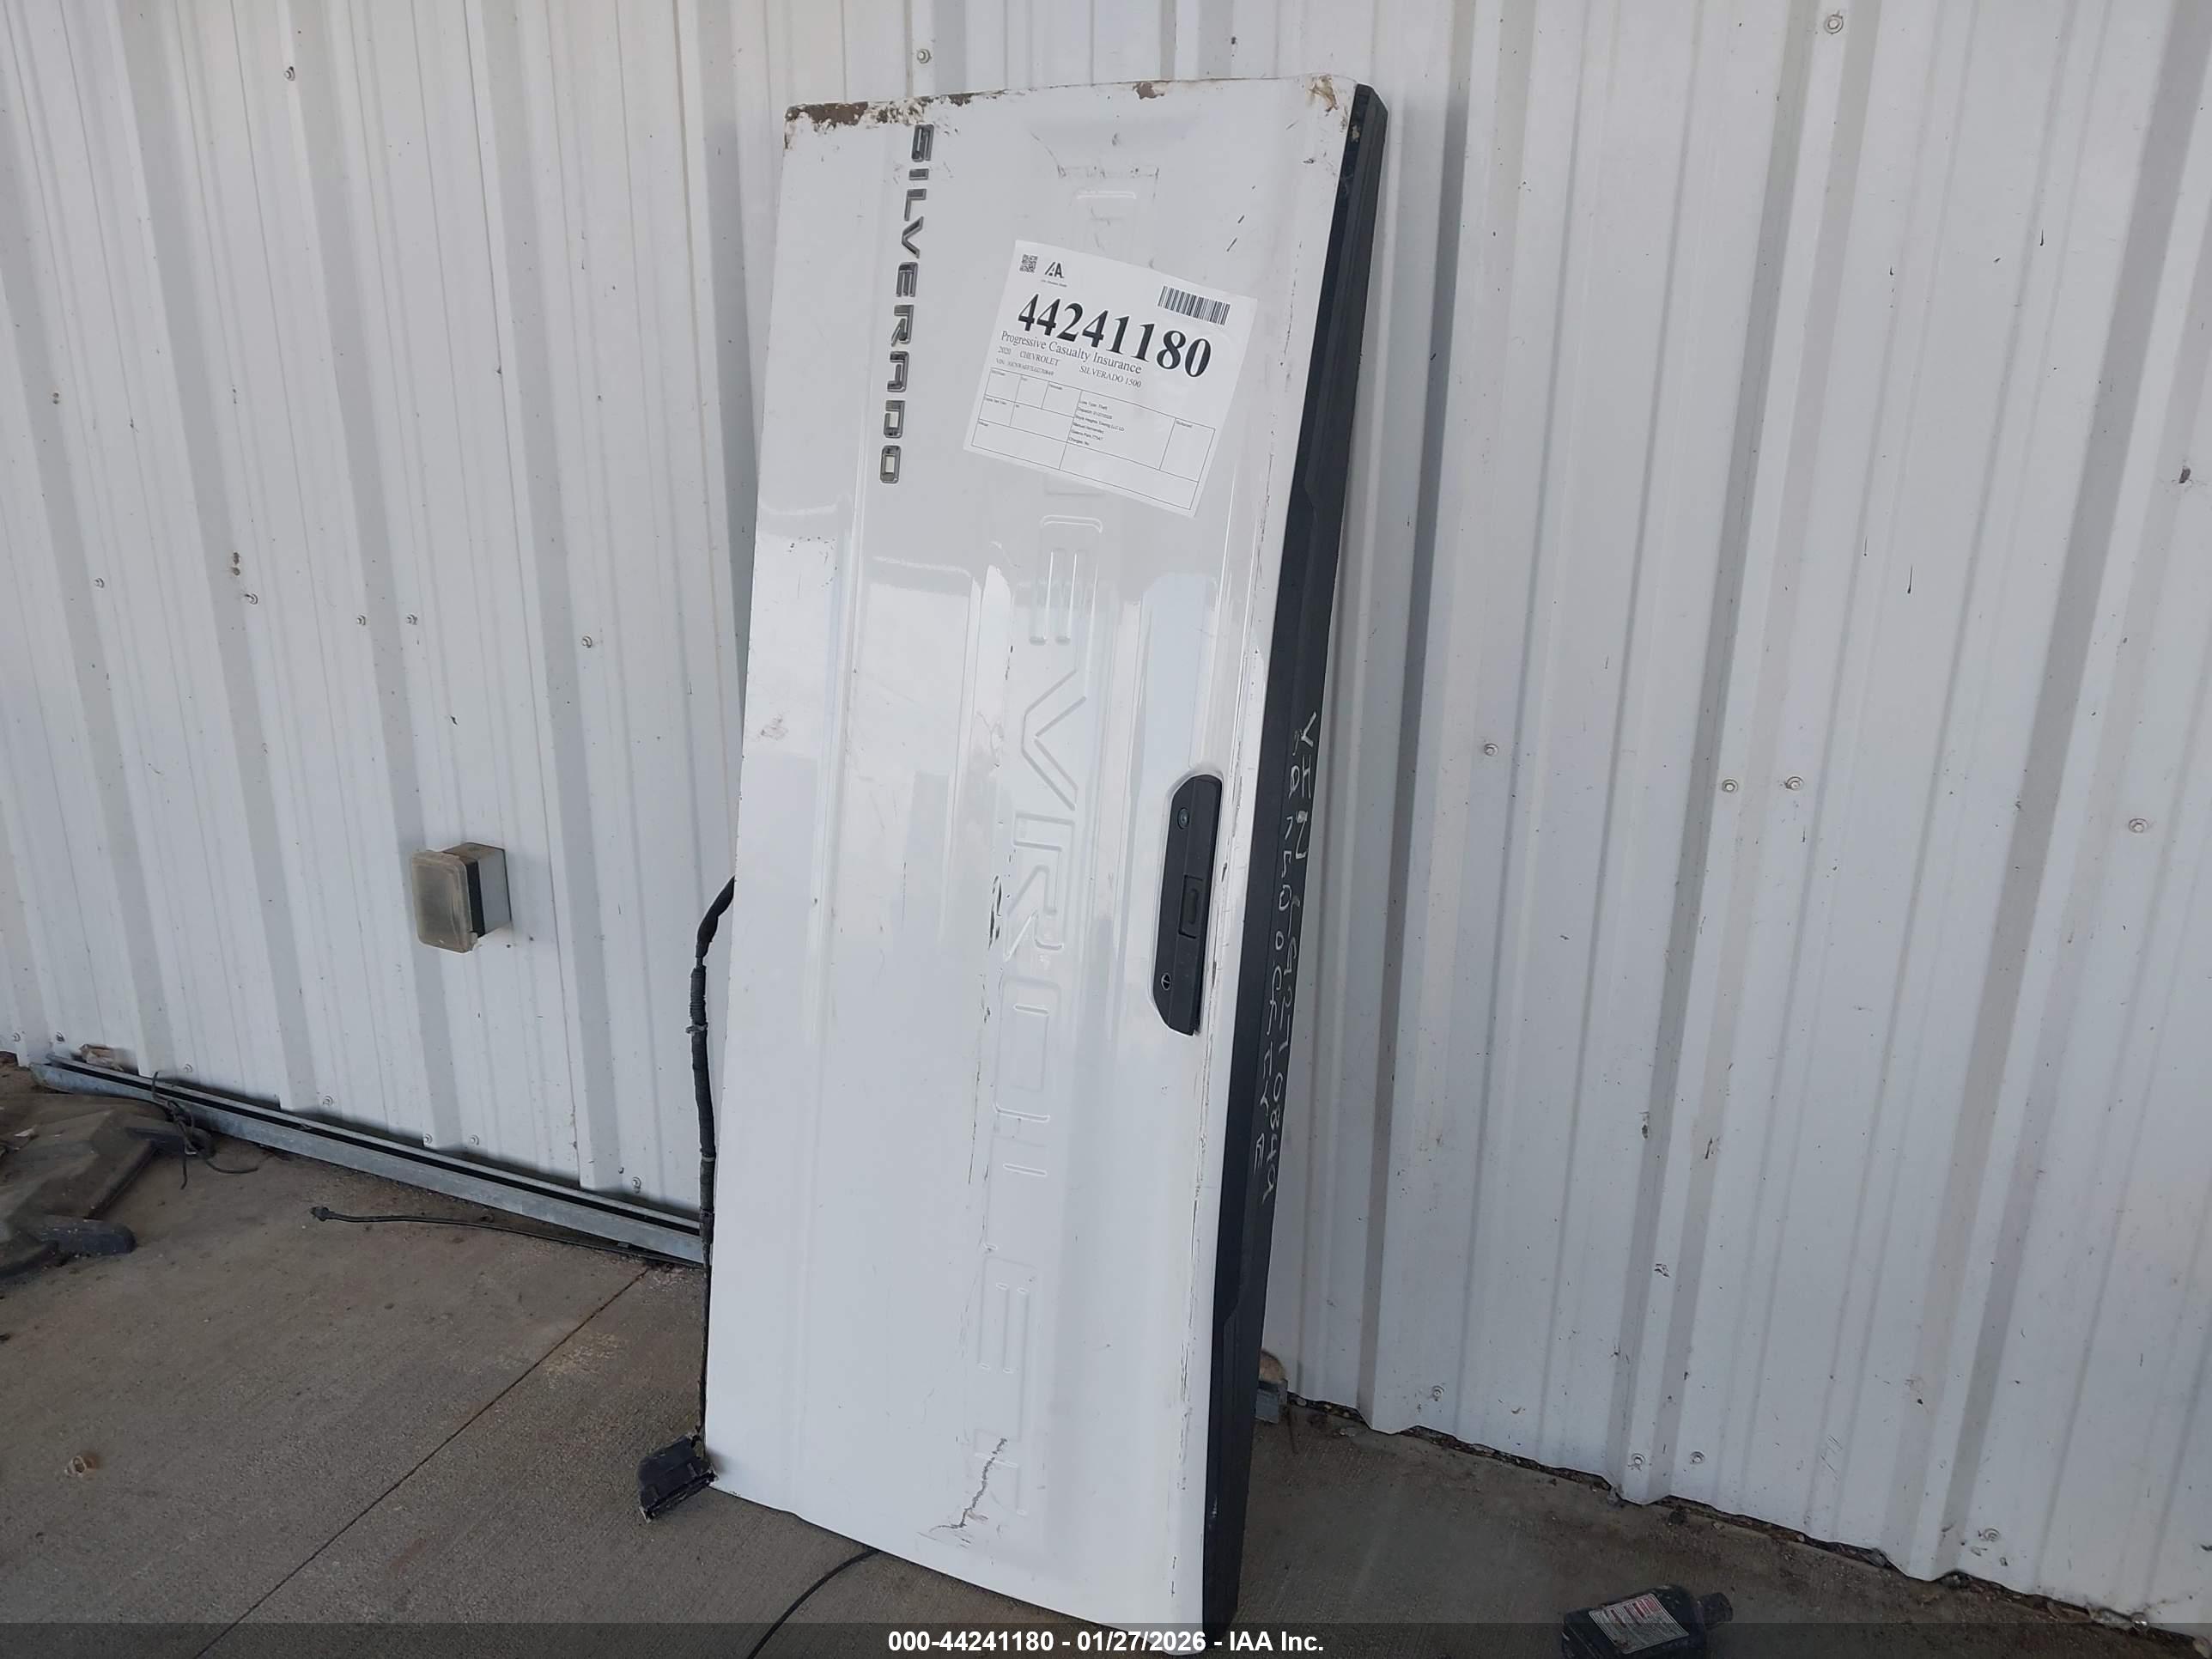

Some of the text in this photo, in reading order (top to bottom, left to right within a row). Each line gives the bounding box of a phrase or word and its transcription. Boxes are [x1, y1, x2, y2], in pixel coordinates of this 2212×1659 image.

[880, 124, 934, 483] SILVERADO
[1001, 330, 1142, 374] Progressive Casualty Insurance
[1018, 294, 1212, 378] 44241180
[1019, 350, 1060, 367] CHEVROLET
[1079, 365, 1123, 384] SILVERADO
[1125, 377, 1142, 388] 1500
